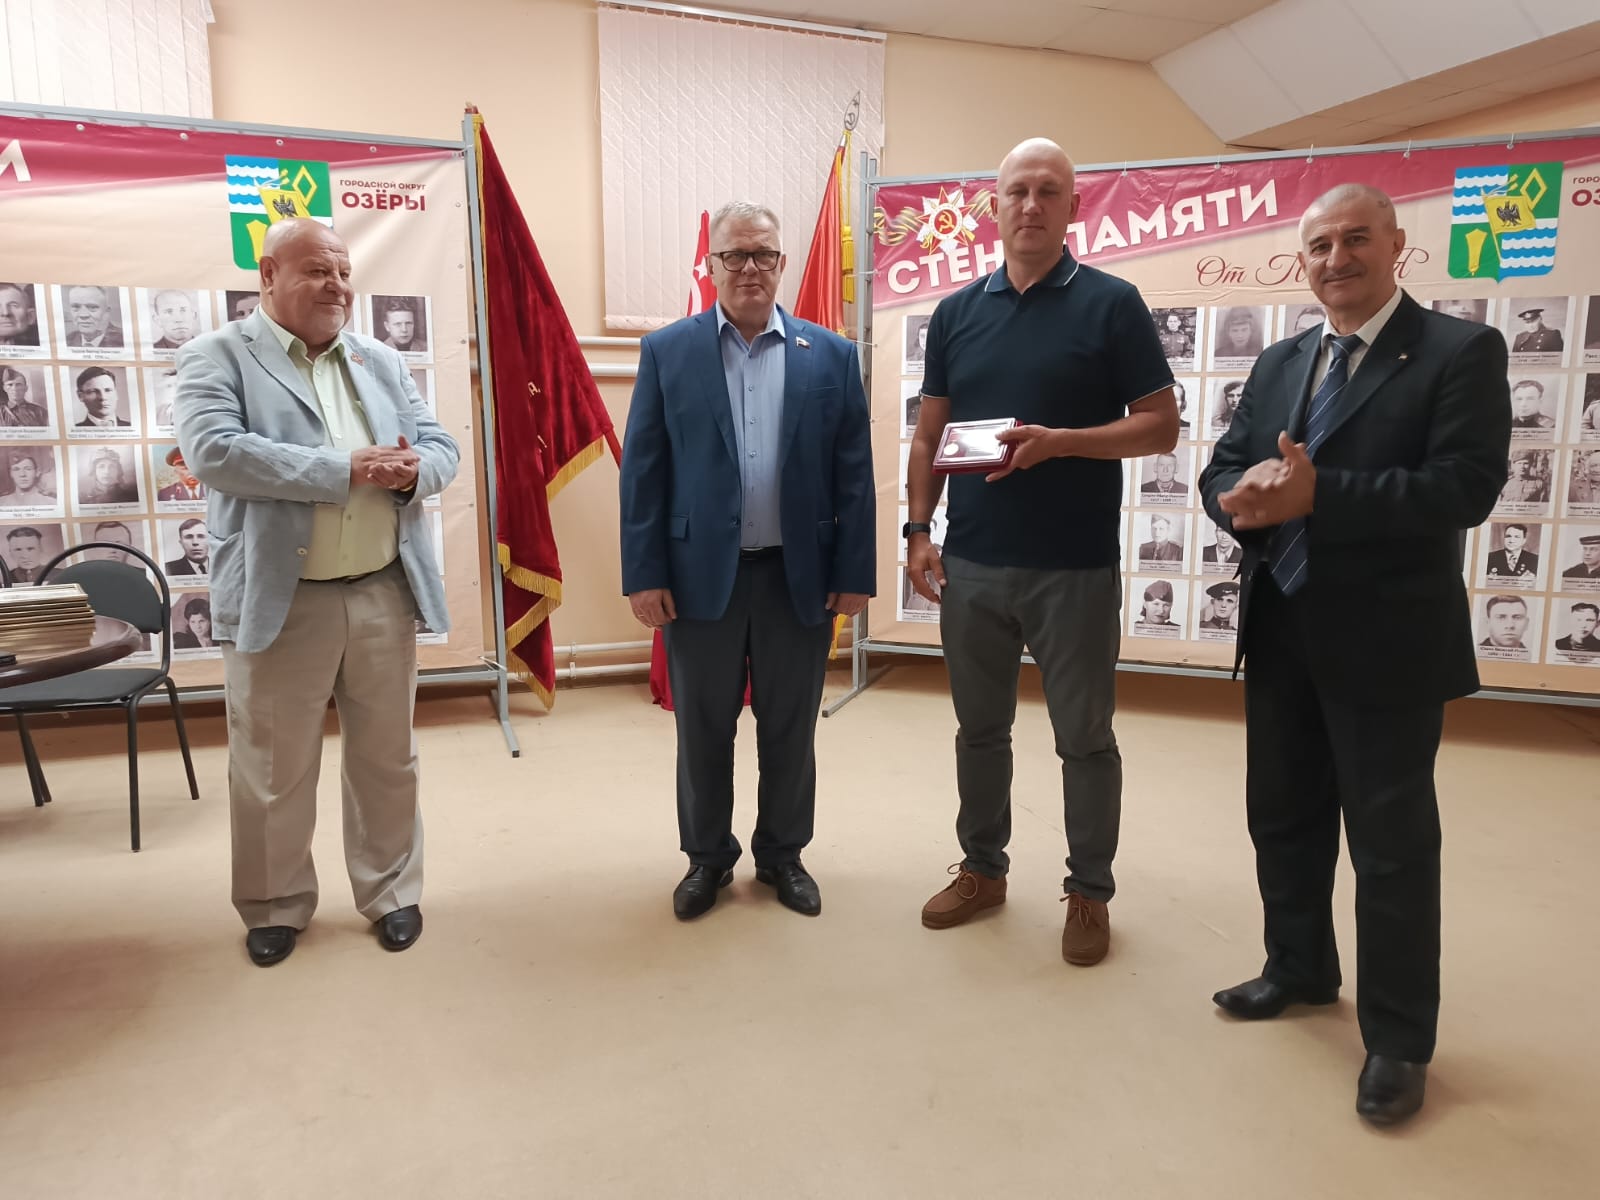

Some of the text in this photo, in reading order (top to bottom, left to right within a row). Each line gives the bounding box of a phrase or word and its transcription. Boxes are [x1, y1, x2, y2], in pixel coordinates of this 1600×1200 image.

[339, 179, 426, 190] ГОРОДСКОЙ ОКРУГ
[341, 188, 425, 211] ОЗЁРЫ
[887, 178, 1278, 294] СТЕН ПАМЯТИ
[1196, 255, 1249, 287] От
